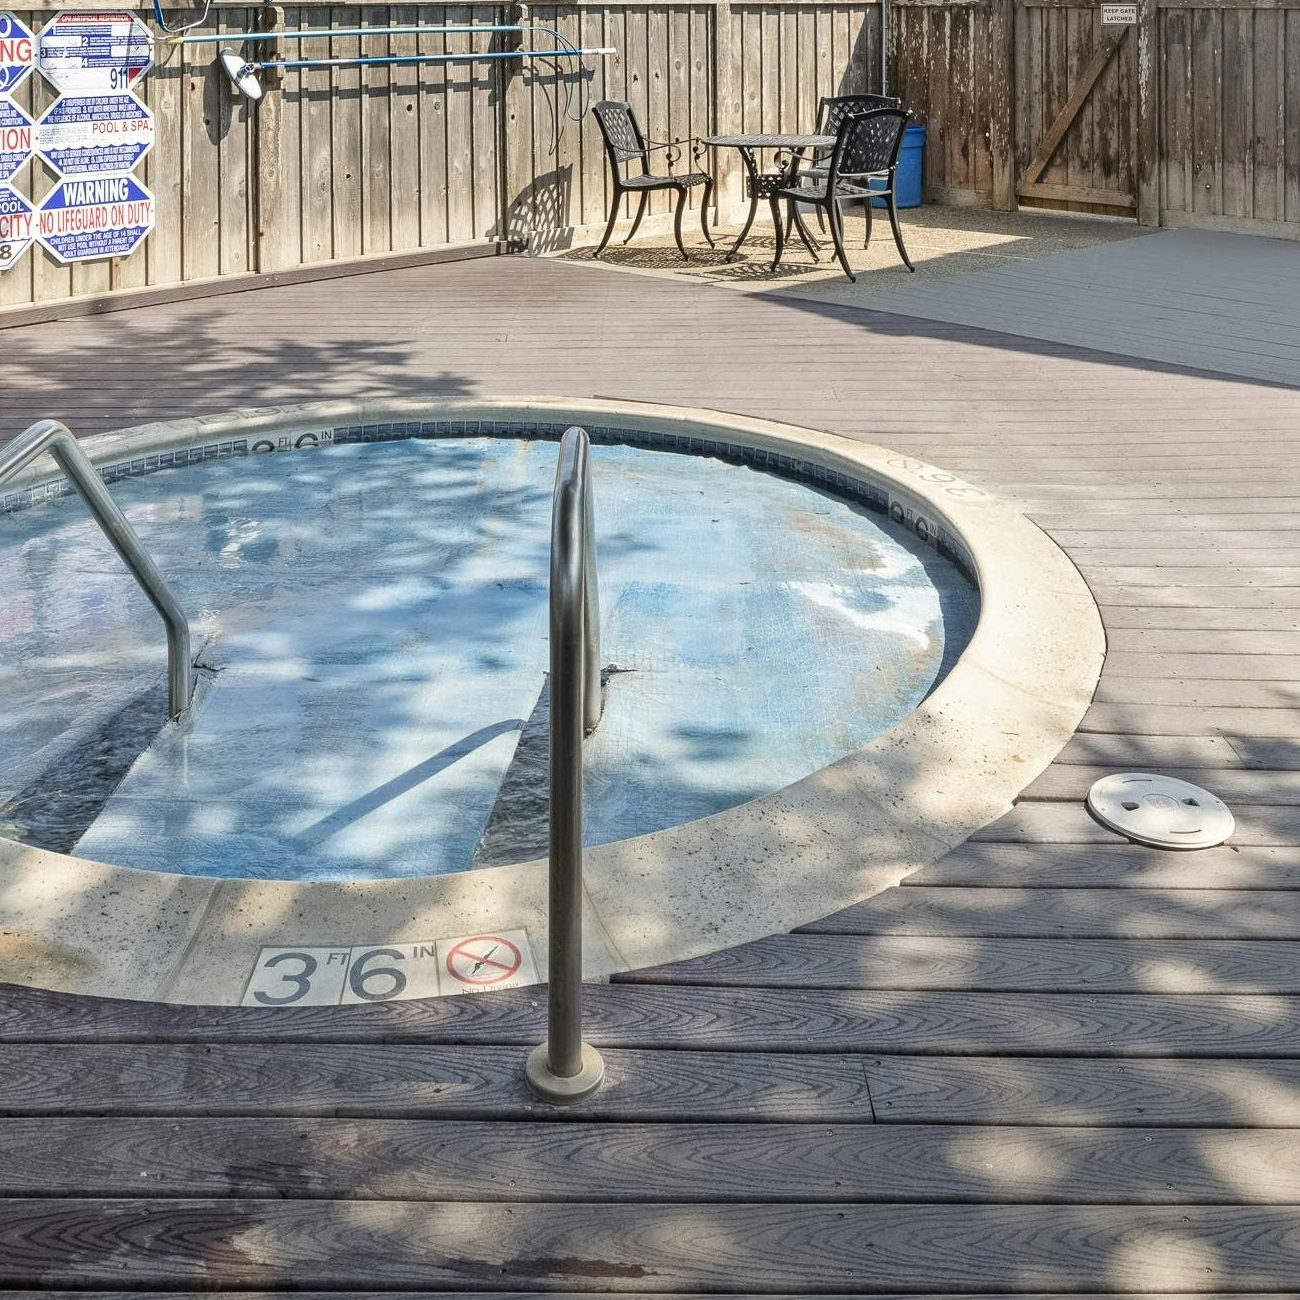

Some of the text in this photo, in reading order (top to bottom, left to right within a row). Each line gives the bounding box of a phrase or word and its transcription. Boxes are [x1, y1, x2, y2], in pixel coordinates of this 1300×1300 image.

[82, 37, 89, 46] 2
[40, 48, 46, 57] 3
[82, 58, 88, 67] 4
[110, 67, 128, 90] 911
[92, 122, 119, 134] POOL
[122, 121, 128, 132] &
[130, 120, 149, 131] SPA
[63, 178, 129, 206] WARNING
[40, 202, 151, 234] NO LIFEGUARD ON DUTY
[50, 237, 75, 245] CHILDREN
[75, 235, 92, 243] UNDER
[93, 233, 102, 241] THE
[113, 230, 120, 238] OF
[77, 241, 88, 249] POOL
[88, 240, 108, 248] WITHOUT
[112, 237, 128, 245] PARENT
[0, 244, 12, 260] 8
[321, 431, 332, 440] IN
[253, 946, 435, 1006] 3 FT 6 IN
